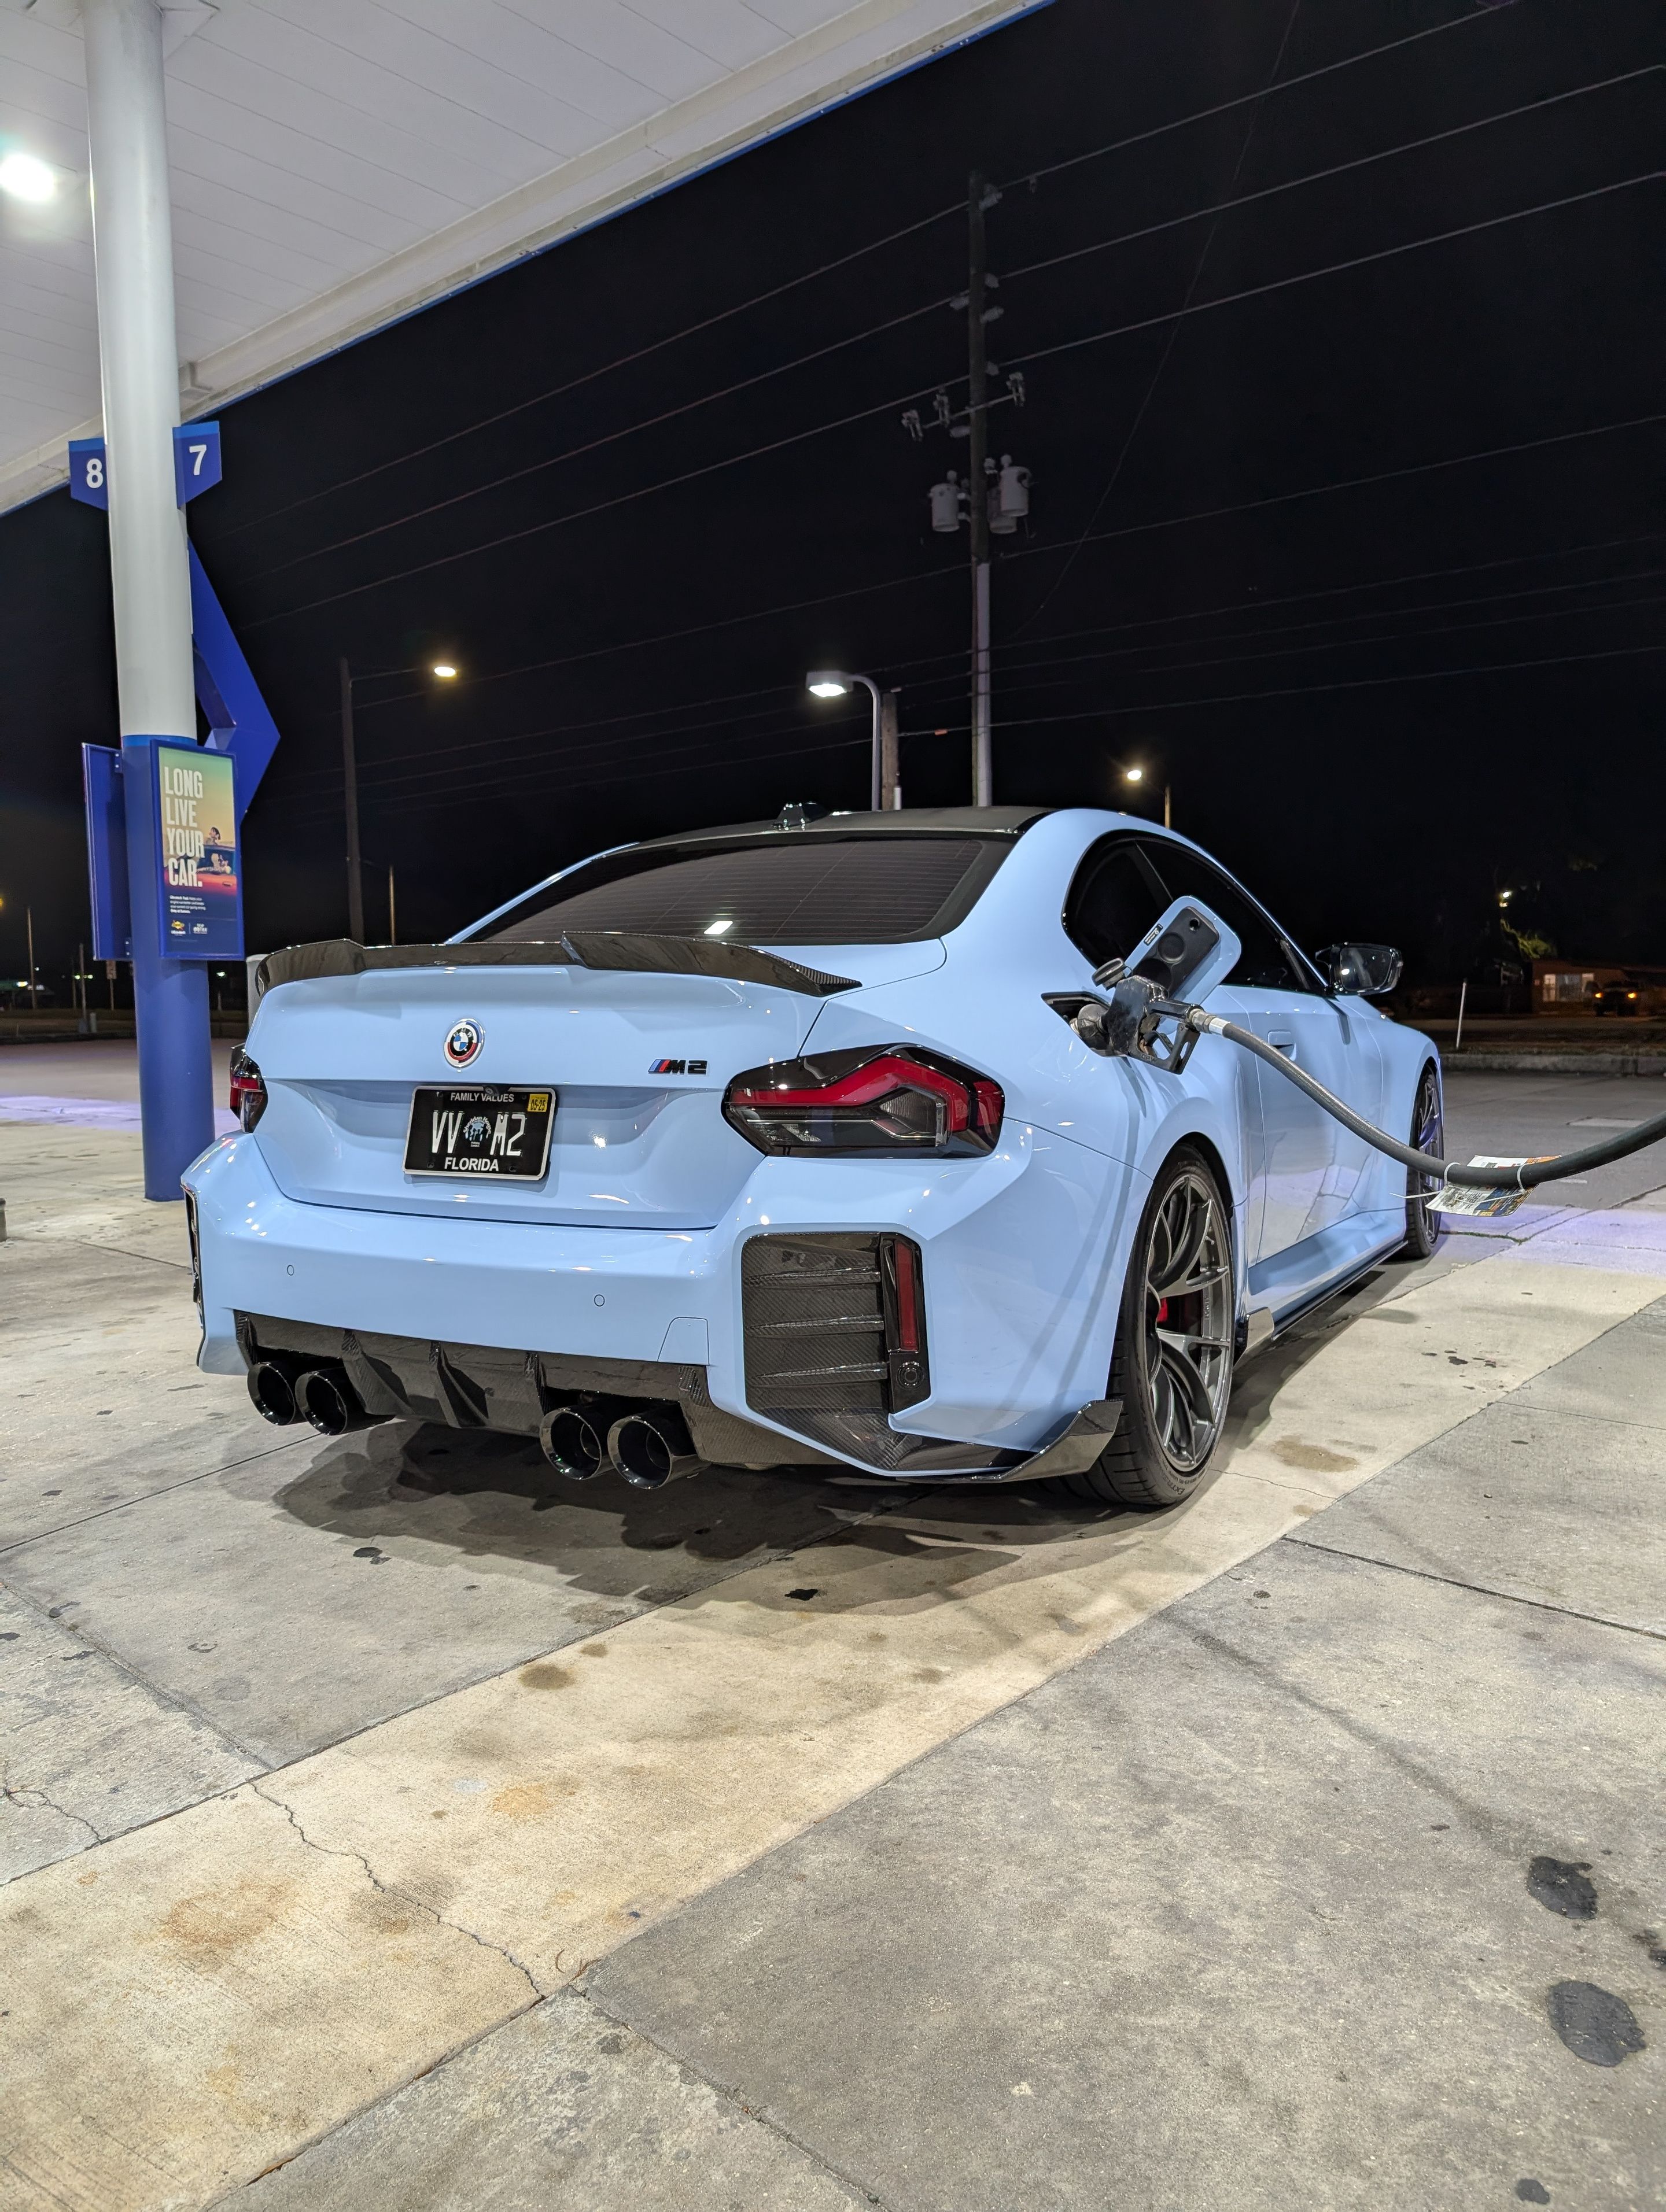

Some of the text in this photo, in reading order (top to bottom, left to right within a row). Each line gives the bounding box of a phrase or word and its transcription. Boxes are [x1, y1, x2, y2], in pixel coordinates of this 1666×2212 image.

[86, 459, 104, 489] 8
[189, 444, 207, 475] 7
[164, 766, 204, 799] LONG
[165, 797, 197, 828] LIVE
[167, 827, 205, 858] YOUR
[168, 858, 202, 888] CAR.
[453, 1027, 473, 1038] BMW
[661, 1058, 708, 1074] M2
[450, 1092, 480, 1102] FAMILY
[530, 1099, 546, 1111] 05-25
[432, 1110, 527, 1157] VV M2
[444, 1157, 499, 1172] FLORIDA
